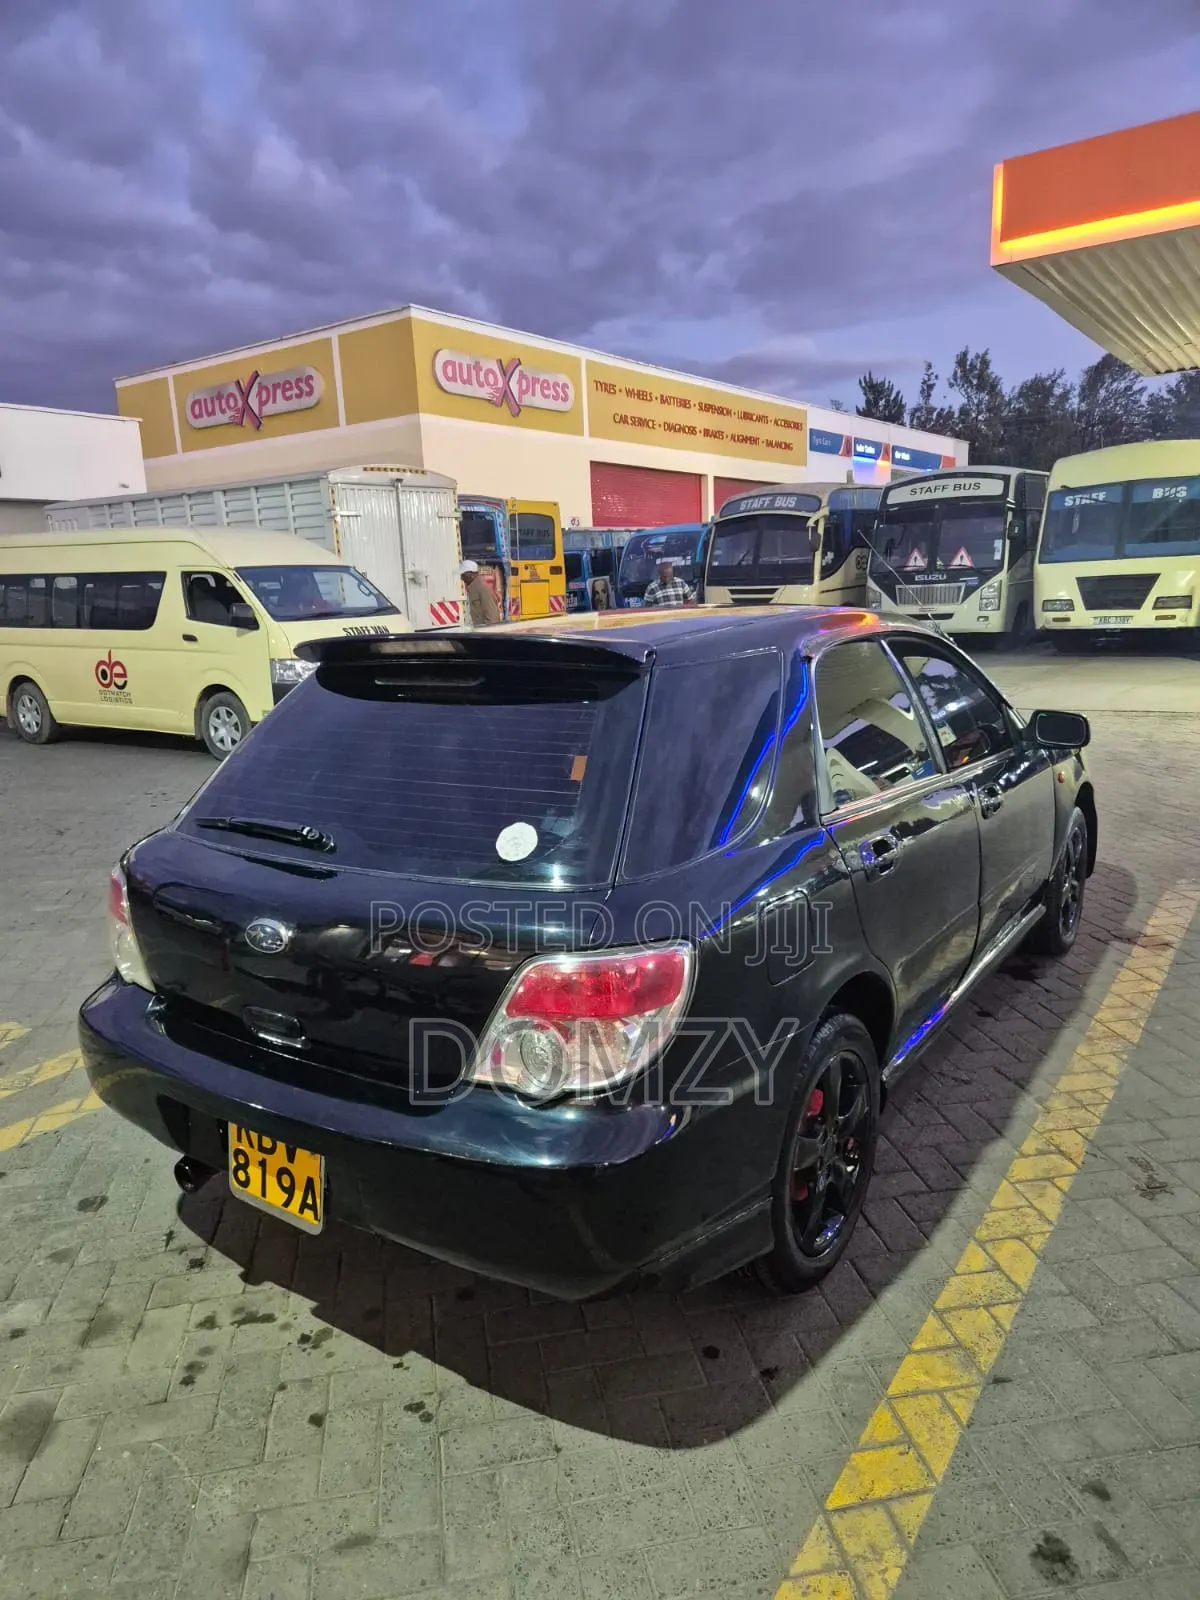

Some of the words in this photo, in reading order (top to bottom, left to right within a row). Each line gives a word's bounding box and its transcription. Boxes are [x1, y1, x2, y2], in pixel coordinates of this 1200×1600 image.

[190, 370, 315, 431] autoXpress
[442, 358, 570, 417] autoXpress
[593, 380, 617, 395] TYRES
[625, 387, 653, 402] WHEELS
[660, 394, 692, 409] BATTERIES
[698, 402, 732, 417] SUSPENSION
[738, 410, 769, 424] LUBRICANTS
[773, 418, 803, 431] ACCESSORIES
[613, 413, 629, 427] CAR
[630, 415, 656, 430] SERVICE
[663, 422, 698, 436] DIAGNOSIS
[703, 428, 725, 441] BRAKES
[730, 433, 761, 446] ALIGNMENT
[765, 439, 794, 452] BALANCING
[740, 497, 773, 511] STAFF
[774, 496, 798, 508] BUS
[910, 484, 949, 497] STAFF
[953, 482, 981, 491] BUS
[915, 574, 948, 582] ISUZU
[233, 1147, 319, 1222] 819A
